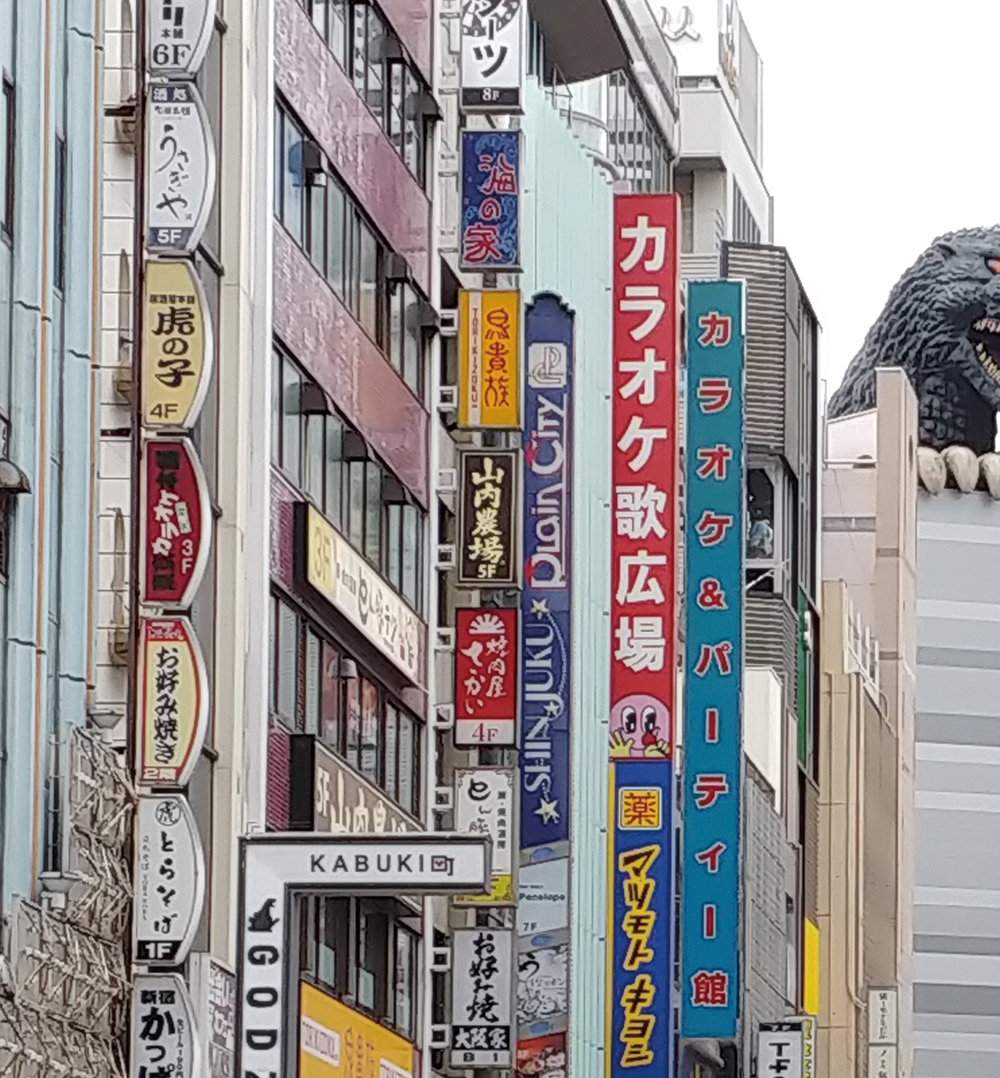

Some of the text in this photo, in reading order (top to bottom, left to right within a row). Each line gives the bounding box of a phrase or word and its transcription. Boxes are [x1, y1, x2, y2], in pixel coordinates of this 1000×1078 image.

[152, 43, 191, 66] 6F
[482, 87, 500, 101] 8F
[156, 123, 190, 219] うさぎや
[463, 153, 518, 264] 海の家
[157, 229, 182, 243] 5F
[152, 306, 196, 388] 虎の子
[150, 403, 179, 419] 4F
[615, 215, 668, 673] カラオケ歌広場
[467, 456, 505, 563] 山内農場
[478, 564, 497, 578] 5F
[460, 641, 487, 715] さかい
[485, 635, 509, 698] 焼肉屋
[518, 622, 565, 792] SHINJUKU
[471, 722, 499, 743] 4F
[623, 792, 656, 825] 薬
[523, 921, 537, 931] 7F
[144, 942, 173, 960] 1F
[618, 845, 661, 1068] マツモトキヨシ
[140, 990, 176, 1004] 新宿
[465, 931, 500, 1023] お好み焼
